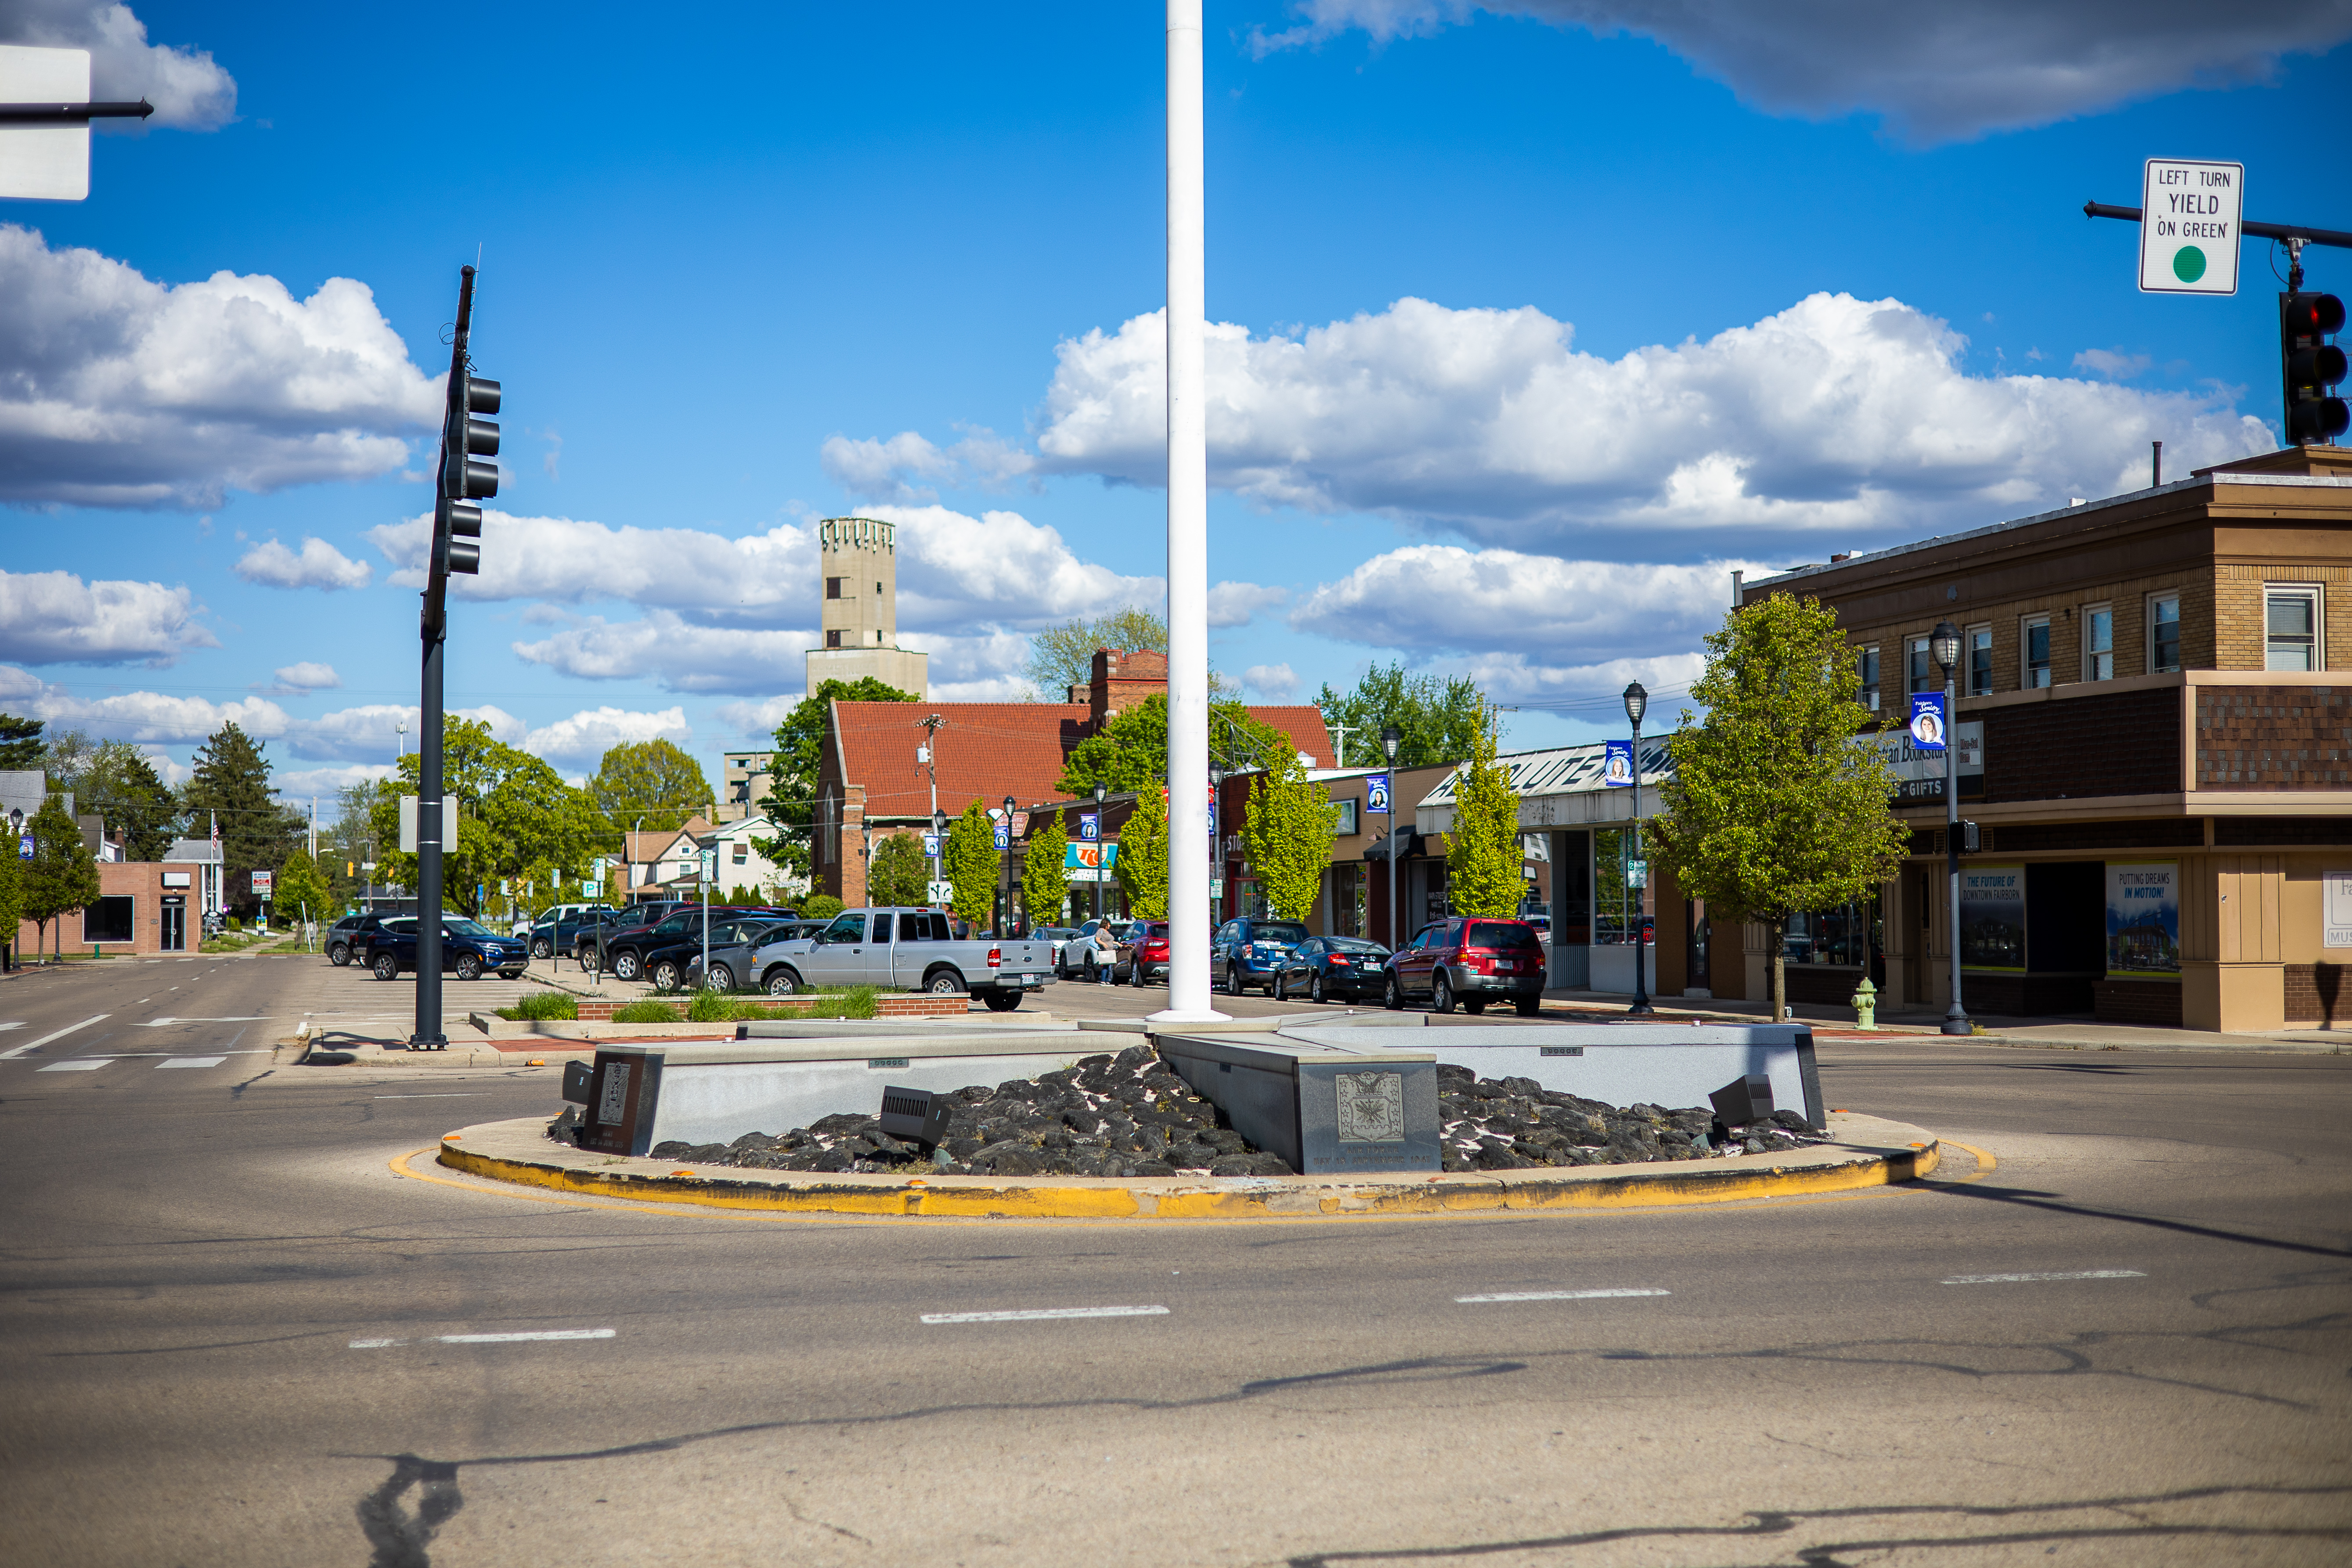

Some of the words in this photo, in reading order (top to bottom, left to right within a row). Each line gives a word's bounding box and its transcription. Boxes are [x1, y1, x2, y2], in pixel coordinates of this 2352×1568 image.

[2159, 169, 2189, 185] LEFT
[2200, 171, 2231, 187] TURN
[2169, 193, 2219, 215] YIELD
[2158, 221, 2175, 236] ON
[2183, 222, 2226, 238] GREEN
[1919, 704, 1940, 712] Senior
[1909, 780, 1941, 796] GIFTS
[1078, 849, 1107, 866] RC
[1967, 876, 1979, 887] THE
[1980, 876, 2006, 887] FUTURE
[2007, 876, 2016, 887] OF
[2119, 873, 2144, 885] PUTTING
[2146, 872, 2170, 884] DREAMS
[587, 884, 594, 894] P
[1963, 890, 1992, 900] DOWNTOWN
[1994, 889, 2020, 900] FAIRBORN
[2125, 887, 2132, 898] IN
[2134, 887, 2164, 898] MOTION!
[1346, 1146, 1363, 1154] AIR
[1367, 1145, 1399, 1154] FORCE
[1313, 1157, 1330, 1165] EST
[1352, 1156, 1405, 1164] SEPTEMBER
[1410, 1155, 1431, 1164] 1947
